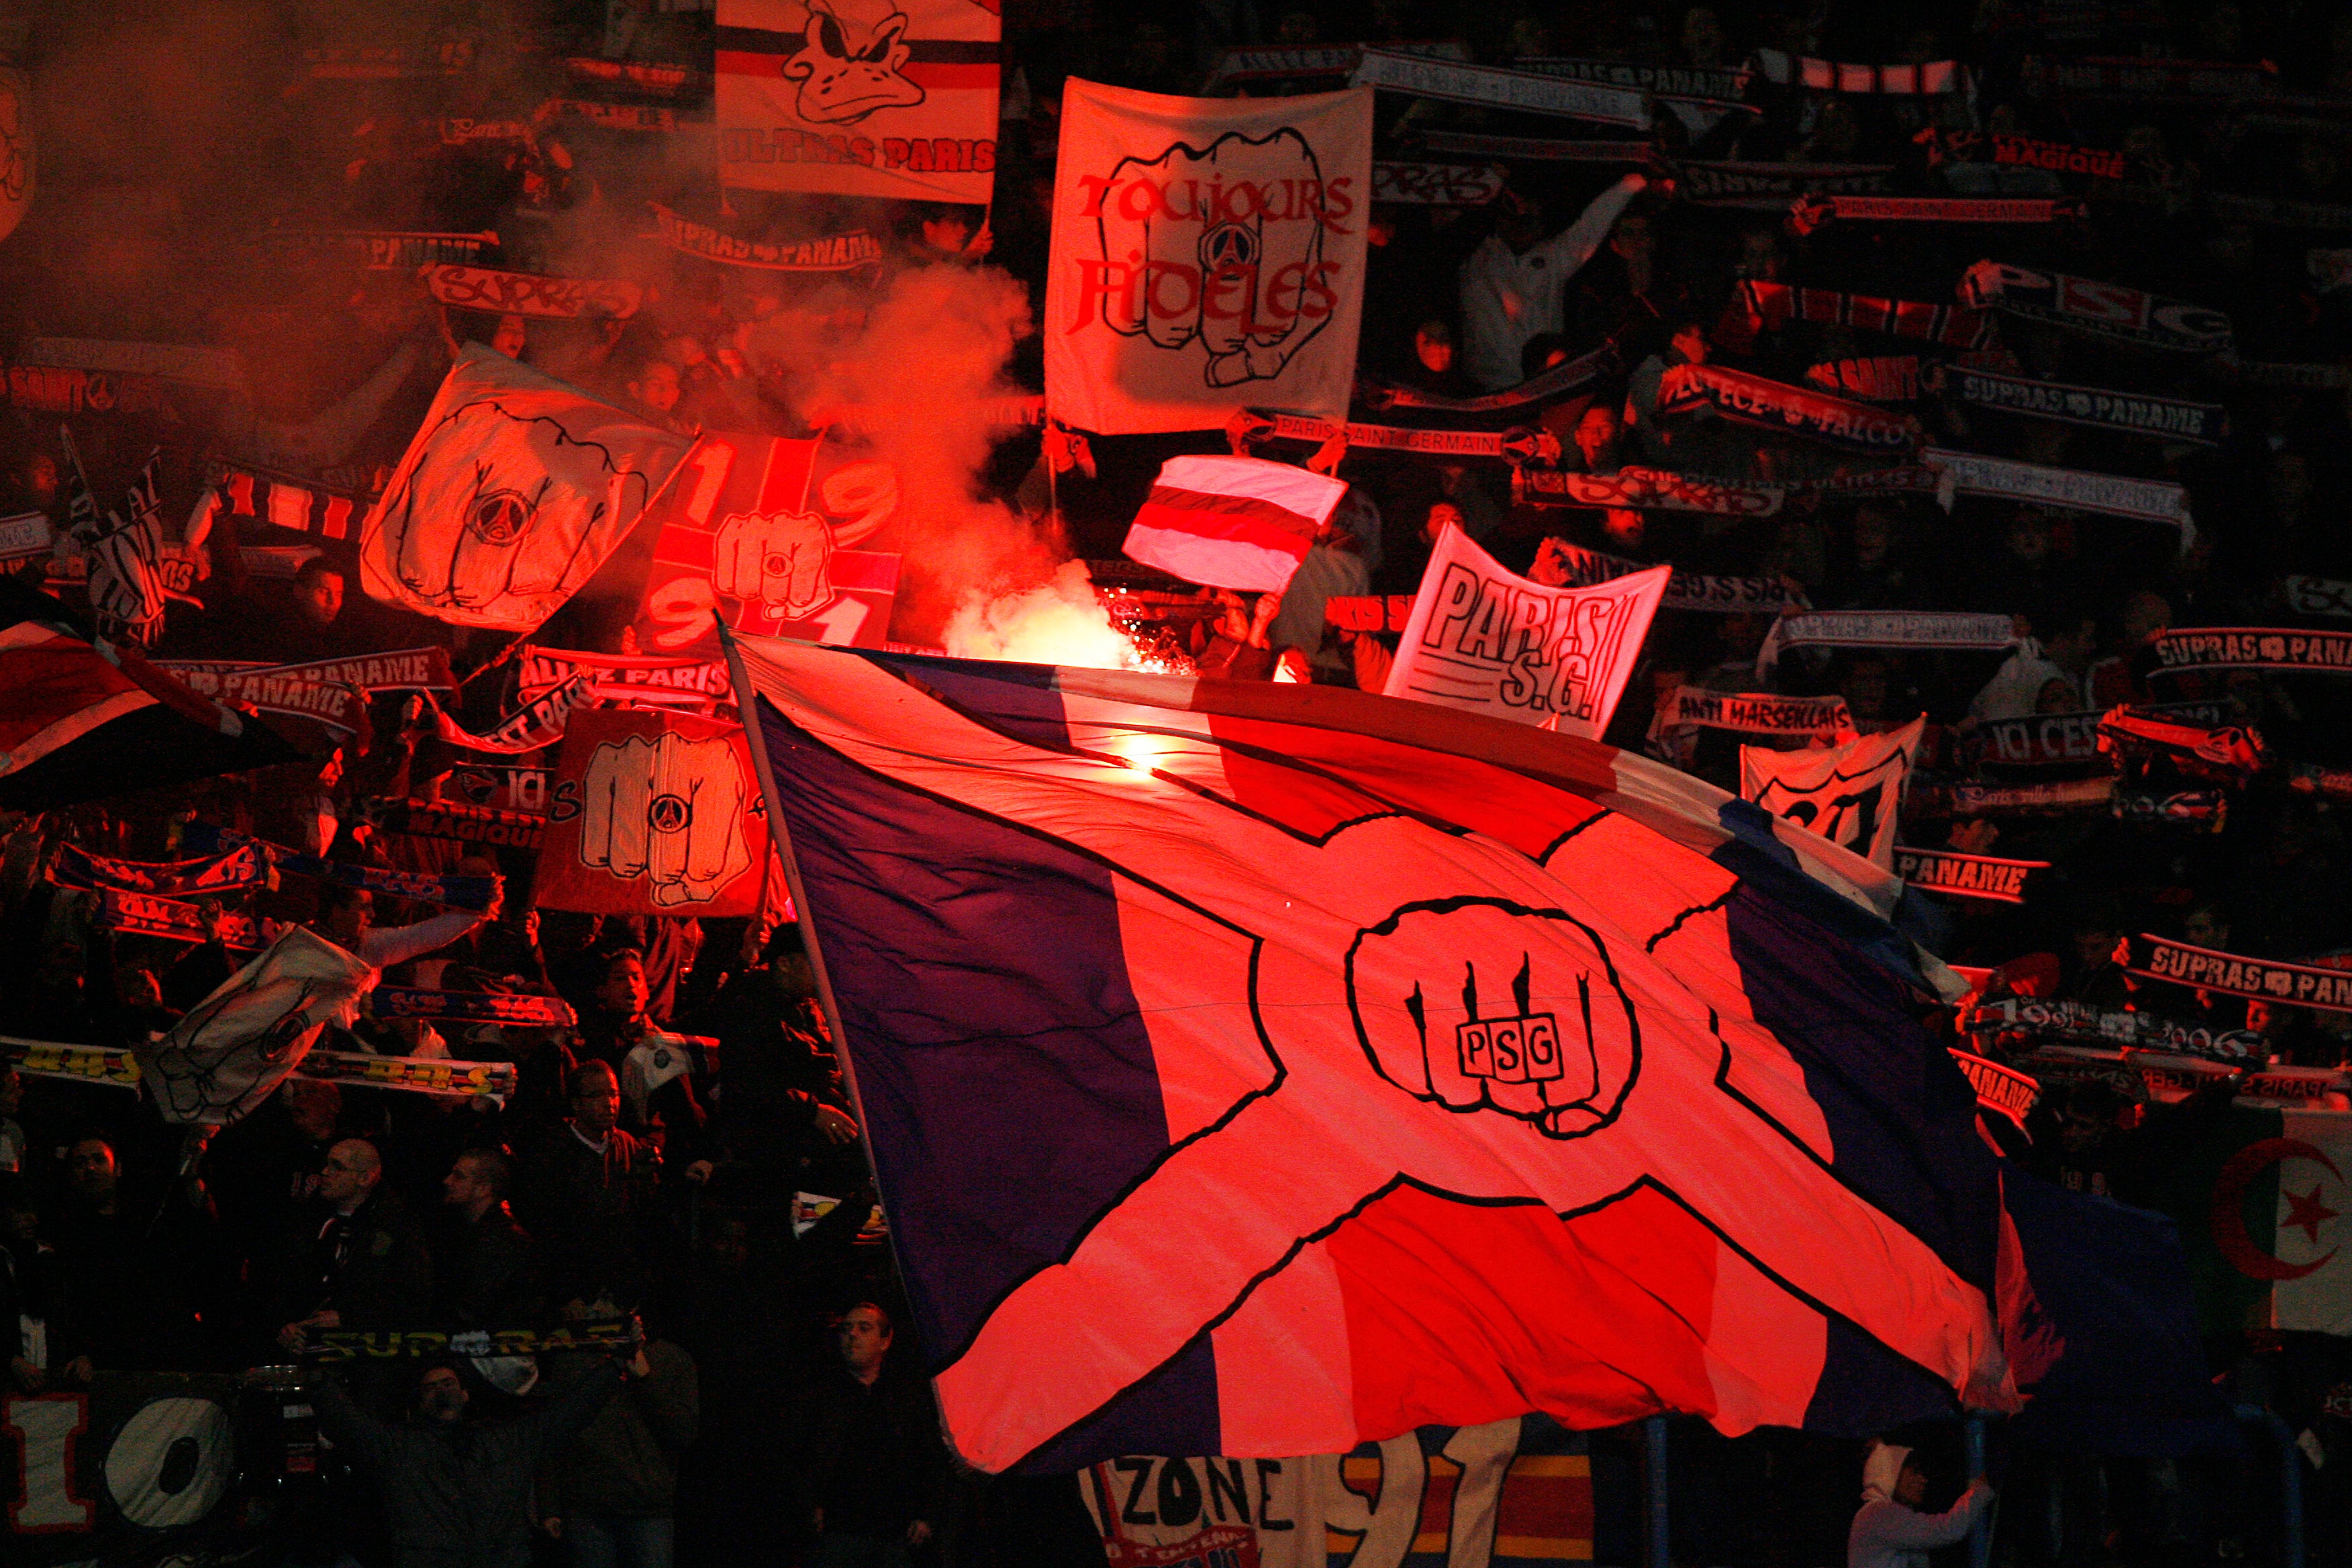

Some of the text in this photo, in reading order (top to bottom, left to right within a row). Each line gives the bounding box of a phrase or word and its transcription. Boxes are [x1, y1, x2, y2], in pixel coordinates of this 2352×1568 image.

[882, 138, 995, 172] PARIS
[1963, 377, 2205, 435] SUPRAS PANAME
[1422, 563, 1616, 667] PARIS
[2155, 634, 2259, 666] SUPRAS
[520, 657, 730, 696] ALLZ PARIS
[1898, 854, 2028, 896] PANAME
[2150, 945, 2263, 993] SUPRAS
[1467, 1026, 1553, 1070] PSG
[1114, 1458, 1295, 1531] ZONE
